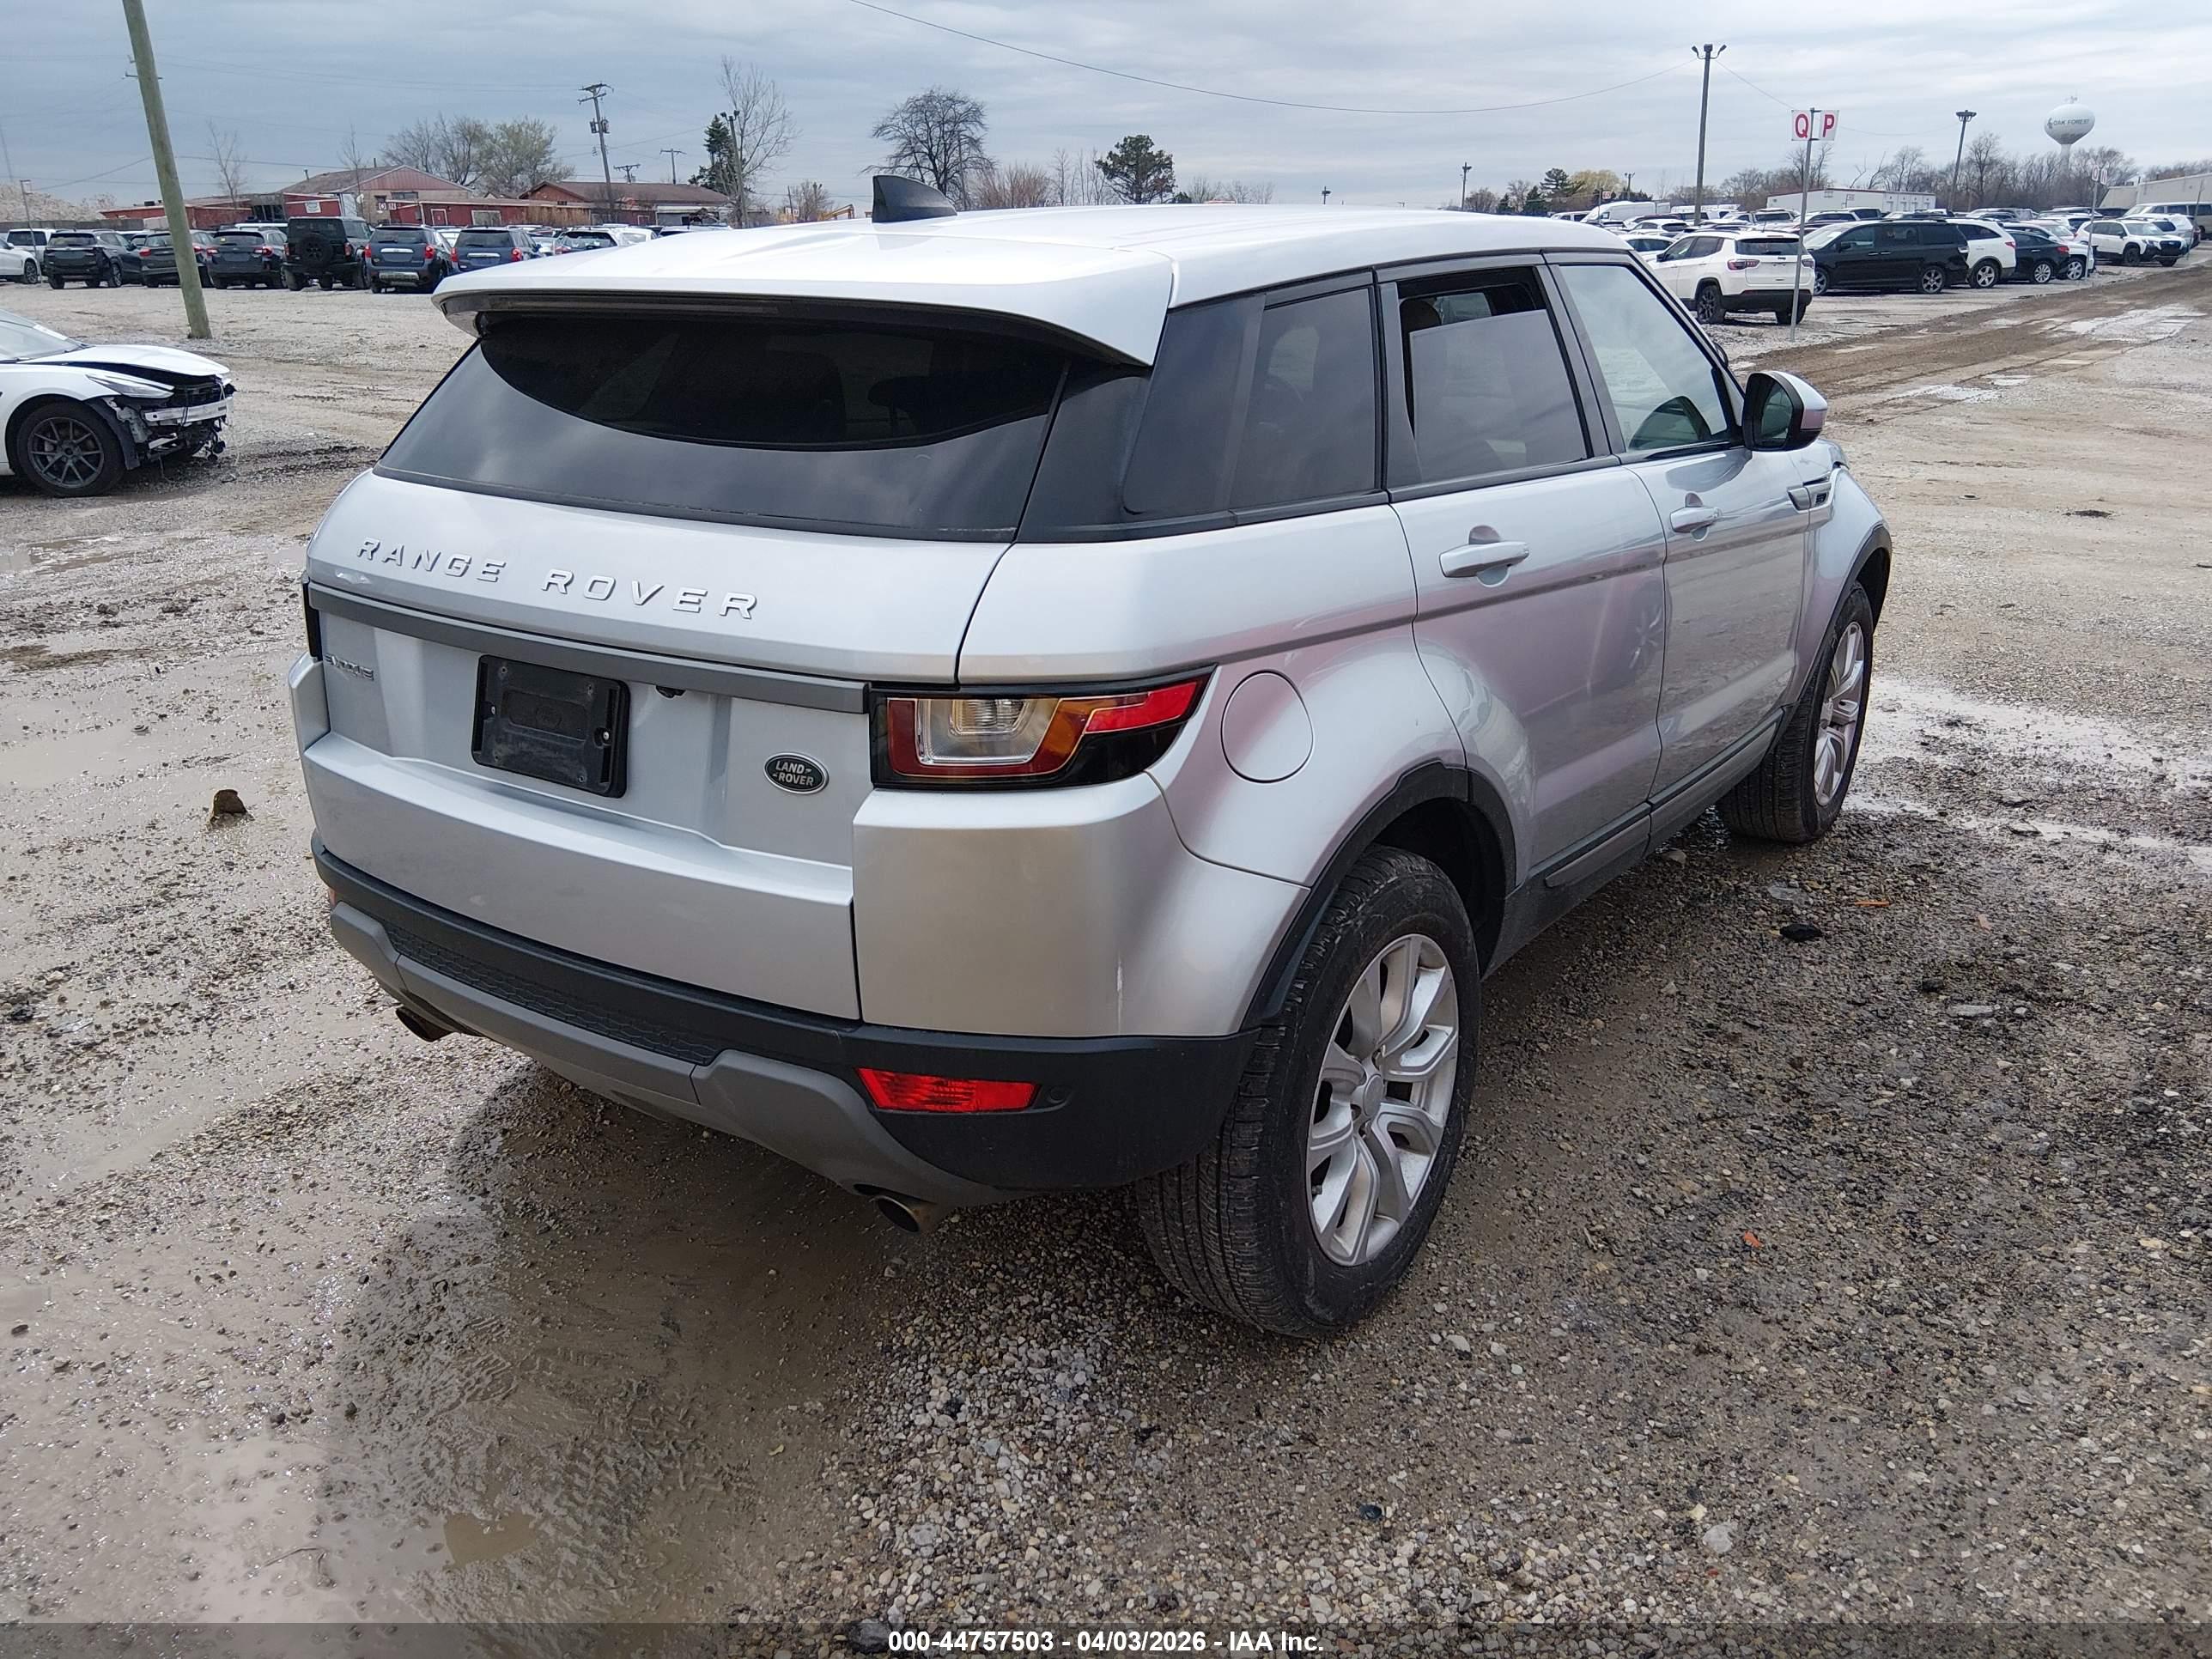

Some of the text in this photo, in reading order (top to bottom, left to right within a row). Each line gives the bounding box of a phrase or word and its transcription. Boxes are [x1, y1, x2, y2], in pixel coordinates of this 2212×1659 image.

[1795, 113, 1809, 138] Q
[1822, 114, 1835, 138] P
[356, 537, 757, 620] RANGE ROVER
[775, 760, 805, 775] LAND
[778, 772, 814, 787] ROVER
